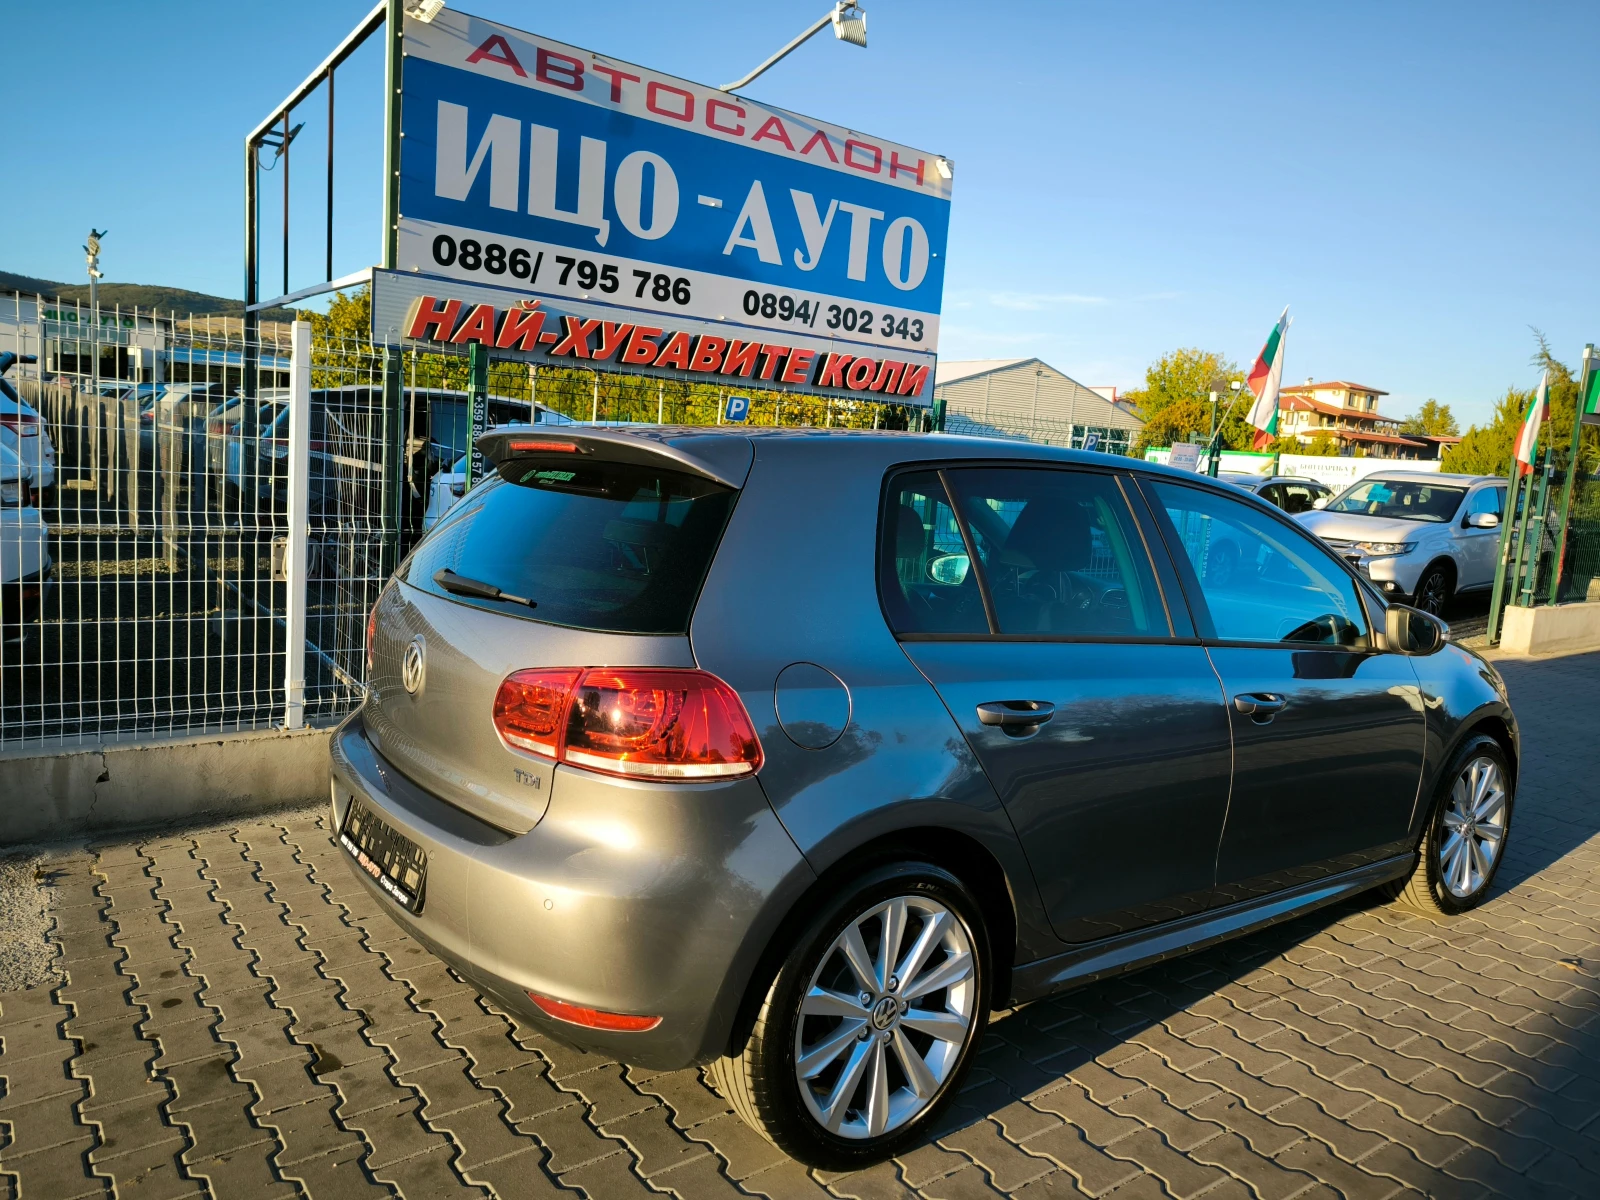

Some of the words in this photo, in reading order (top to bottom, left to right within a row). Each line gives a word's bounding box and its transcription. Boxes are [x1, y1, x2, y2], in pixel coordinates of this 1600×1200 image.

[465, 33, 925, 187] АВТОСАЛОН
[432, 234, 544, 284] 0886/
[555, 256, 620, 294] 795
[632, 269, 691, 305] 786
[743, 290, 820, 328] 0894/
[826, 304, 874, 335] 302
[881, 313, 924, 342] 343
[407, 295, 815, 384] НАЙ-ХУБАВИТЕ
[819, 352, 930, 397] КОЛИ
[473, 395, 484, 421] +359
[730, 399, 745, 418] P
[472, 462, 482, 474] 57
[514, 767, 542, 790] TDI
